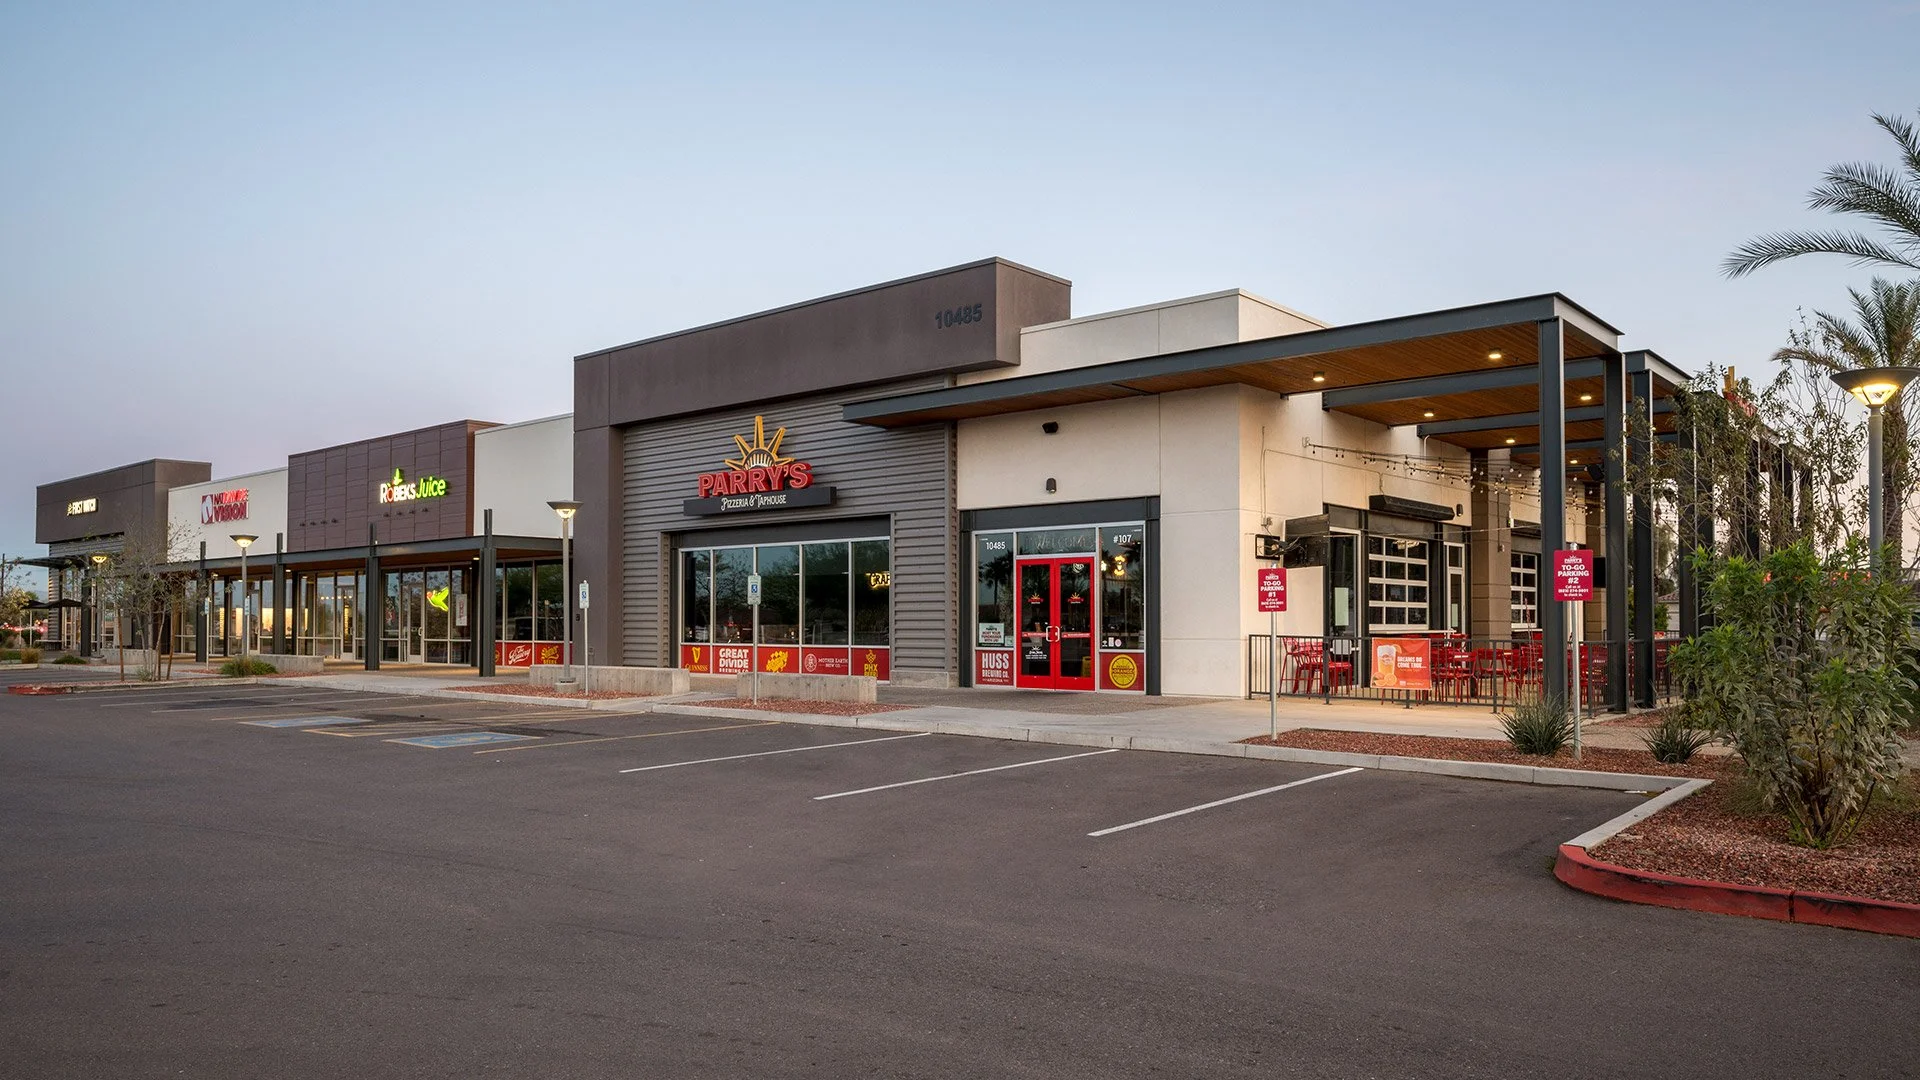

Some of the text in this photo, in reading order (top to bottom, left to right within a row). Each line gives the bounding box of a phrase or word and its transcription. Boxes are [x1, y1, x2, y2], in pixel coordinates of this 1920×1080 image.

[935, 303, 982, 329] 10485
[698, 462, 813, 498] PARRY'S
[416, 476, 446, 499] Juice
[213, 501, 248, 522] VISION
[1113, 534, 1132, 543] #107
[986, 541, 1006, 550] 10485
[719, 648, 749, 659] GREAT
[719, 658, 749, 668] DIVIDE
[982, 652, 1009, 669] HUSS
[864, 663, 878, 672] PHX
[982, 669, 1002, 678] BREWING
